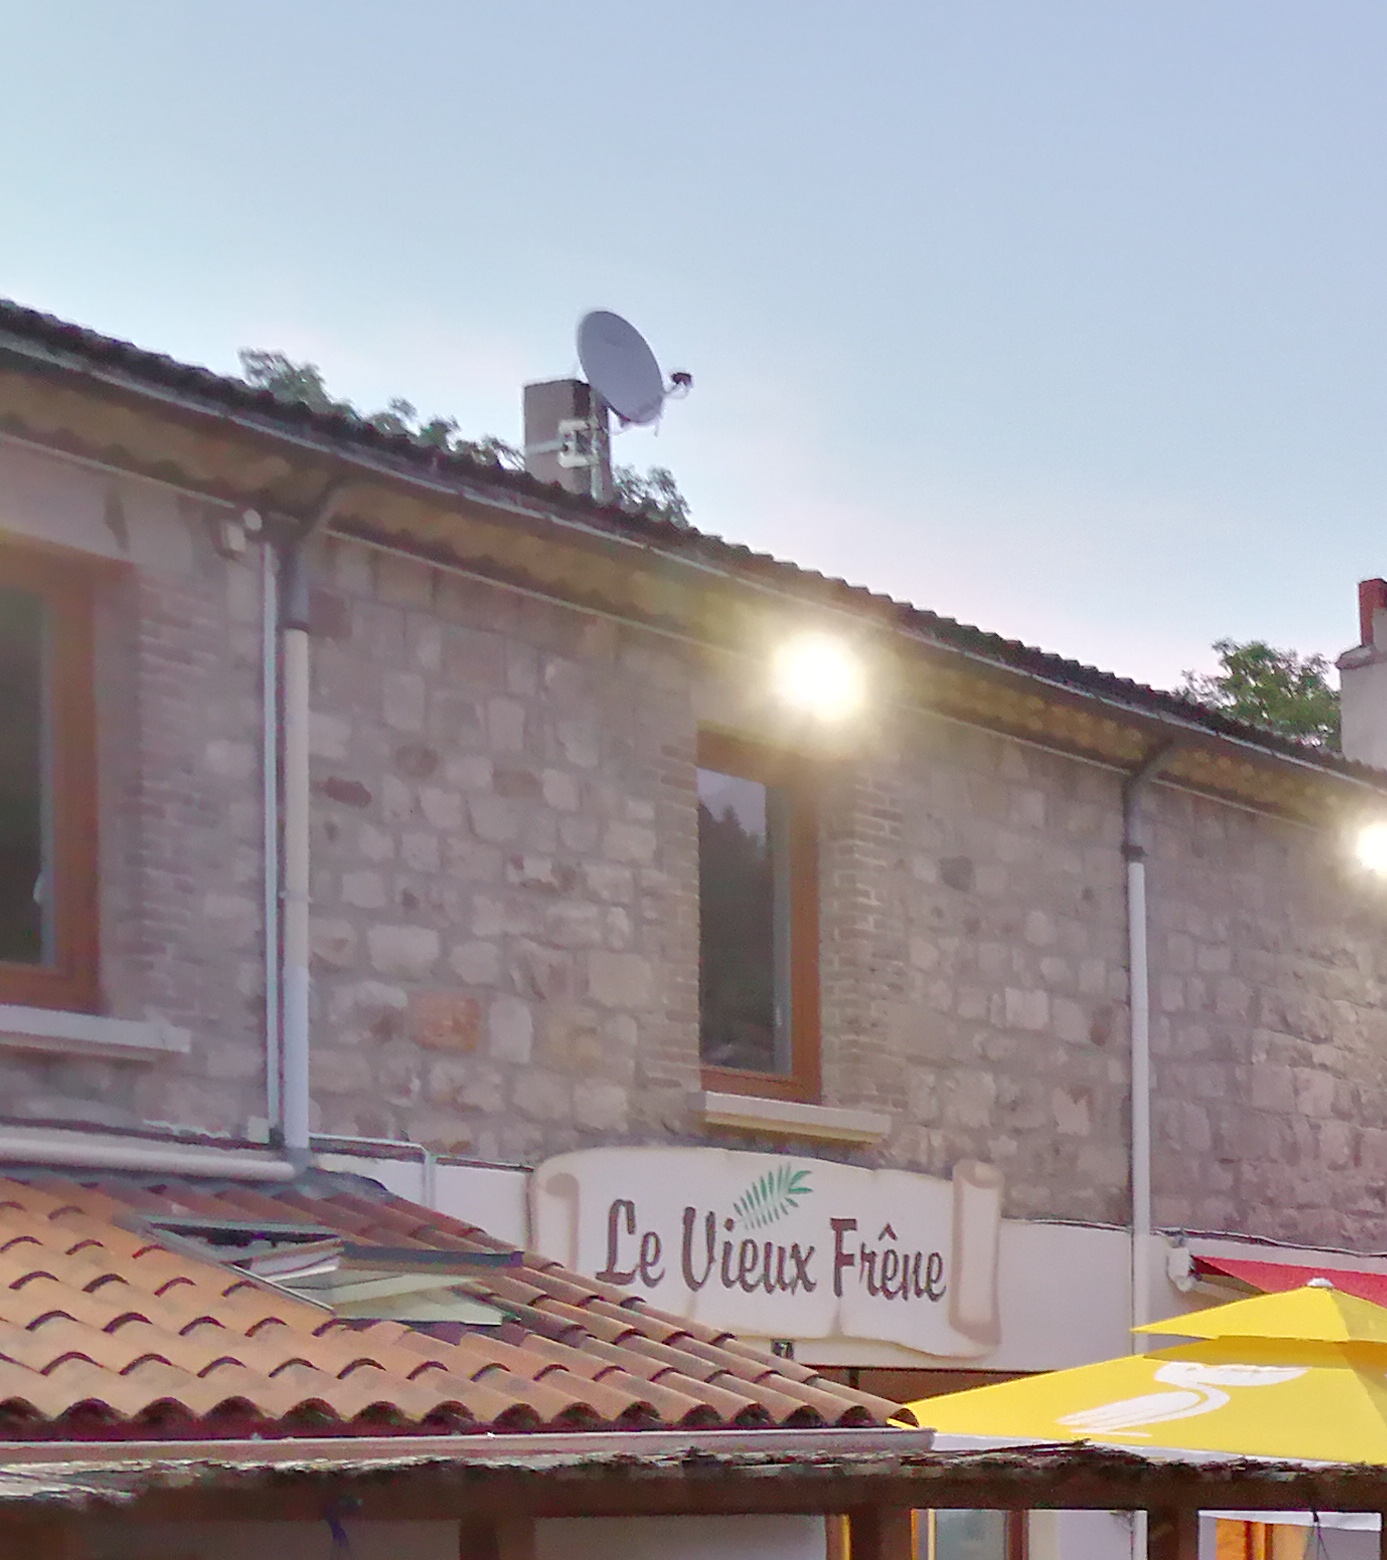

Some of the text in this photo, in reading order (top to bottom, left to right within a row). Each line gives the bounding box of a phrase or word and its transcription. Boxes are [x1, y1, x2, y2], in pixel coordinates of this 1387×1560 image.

[595, 1198, 947, 1302] Le Vieux Frêne
